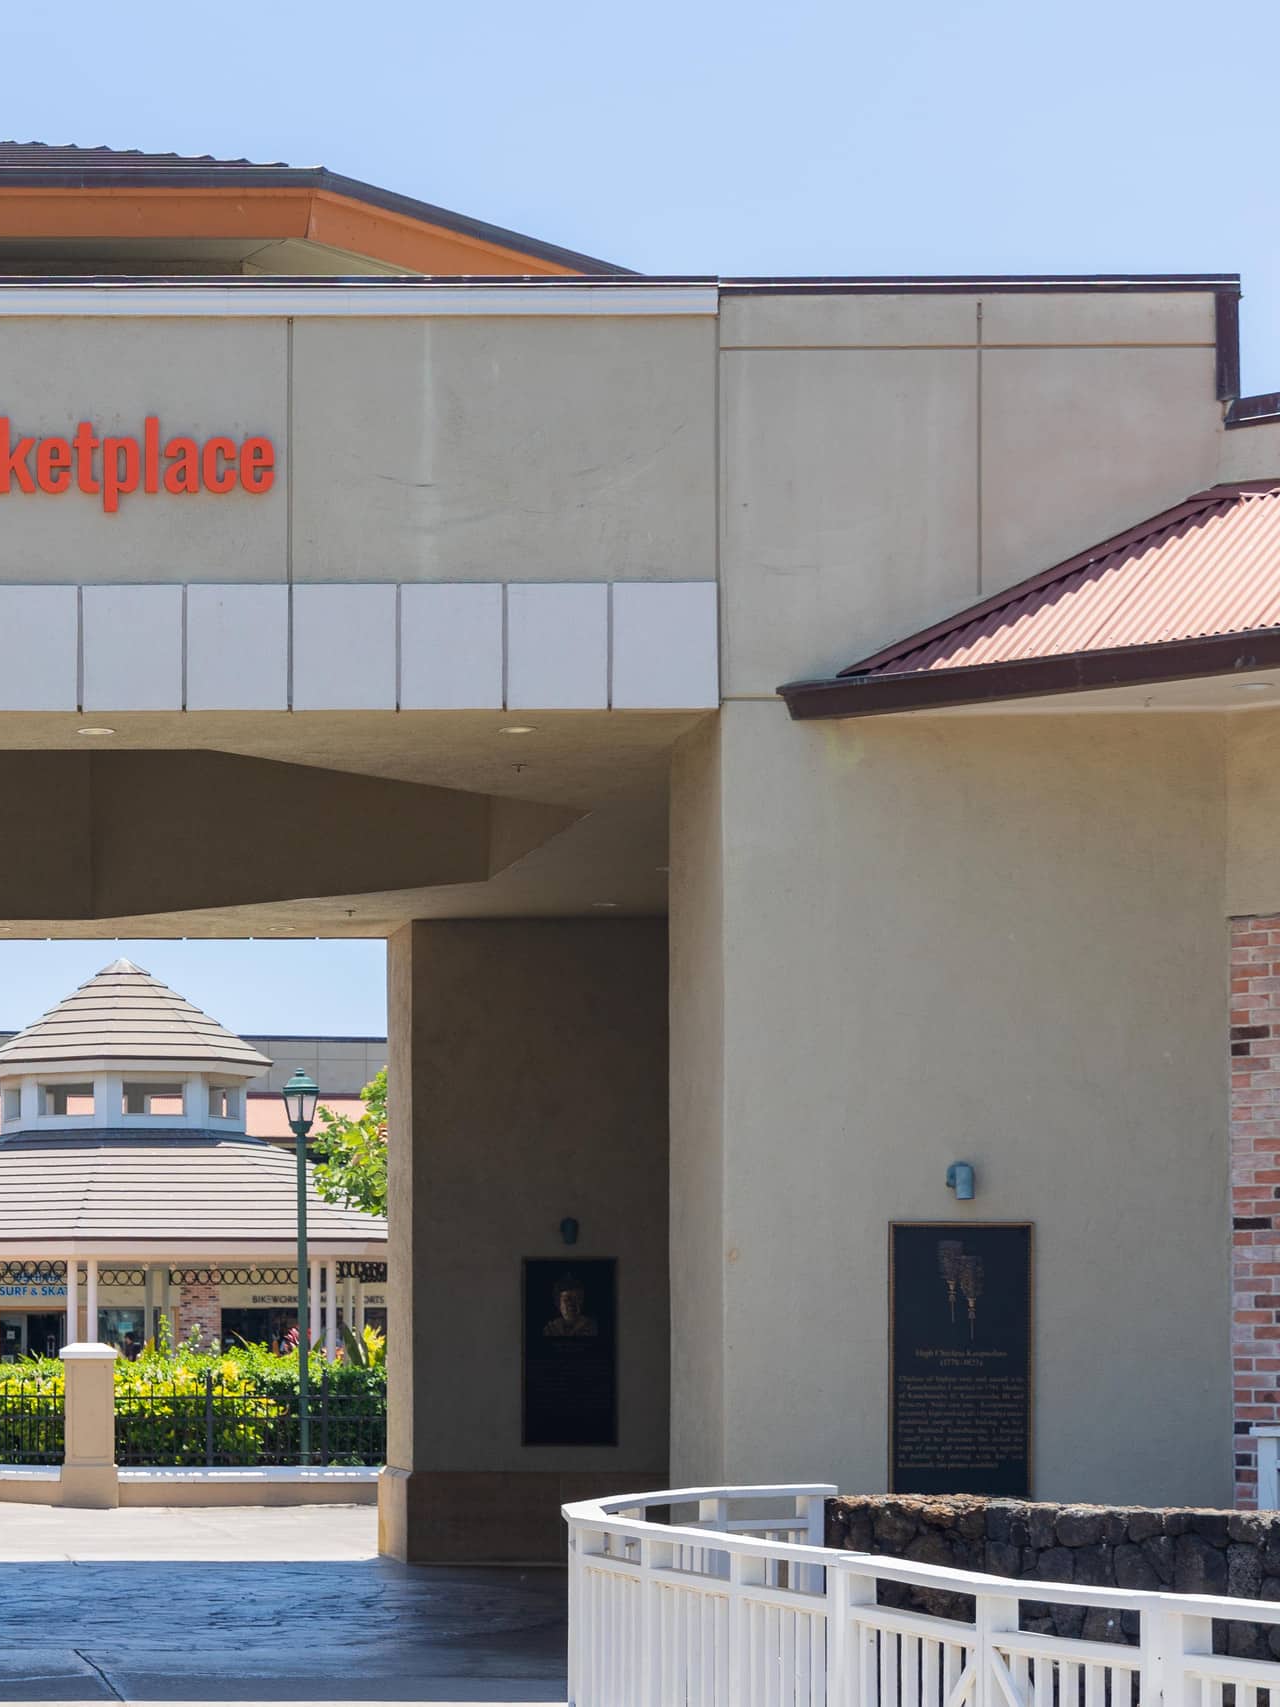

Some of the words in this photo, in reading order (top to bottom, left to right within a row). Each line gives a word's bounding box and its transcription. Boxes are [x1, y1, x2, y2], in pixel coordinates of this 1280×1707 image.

[0, 1286, 28, 1296] SURF
[31, 1286, 38, 1296] &
[252, 1295, 299, 1304] BIKEWORK
